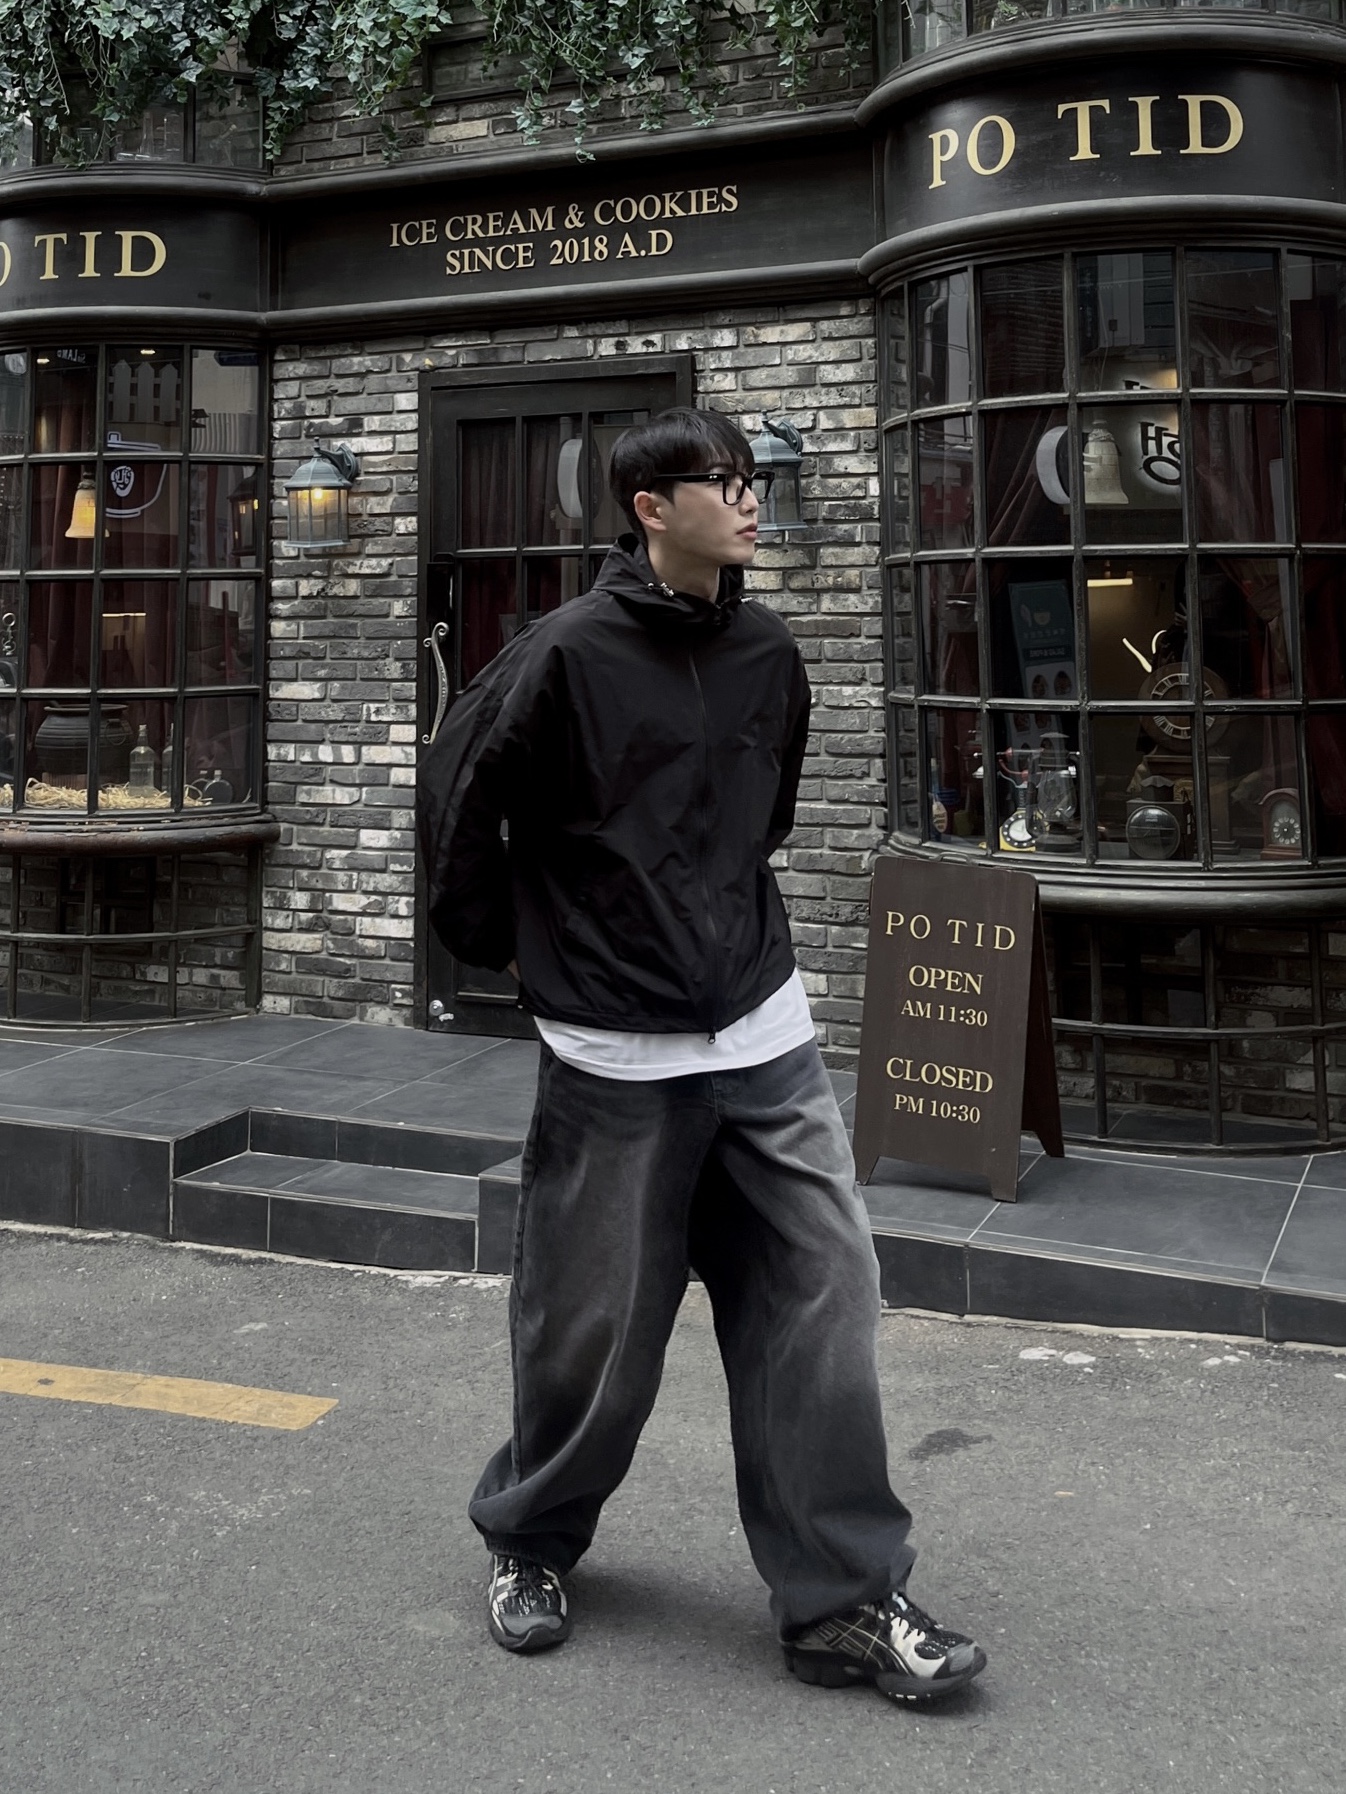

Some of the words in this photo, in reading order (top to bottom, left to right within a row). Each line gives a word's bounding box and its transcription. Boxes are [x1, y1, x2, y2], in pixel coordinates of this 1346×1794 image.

[928, 115, 1016, 189] PO
[1057, 94, 1244, 161] TID
[390, 219, 437, 247] ICE
[444, 206, 556, 241] CREAM
[563, 203, 586, 229] &
[594, 185, 739, 225] COOKIES
[34, 230, 167, 280] TID
[446, 243, 535, 275] SINCE
[549, 235, 609, 265] 2018
[615, 229, 674, 259] A.D
[885, 911, 931, 939] PO
[947, 919, 1016, 950] TID
[908, 965, 984, 995] OPEN
[901, 1000, 931, 1019] AM
[938, 1005, 988, 1027] 11:30
[886, 1057, 993, 1093] CLOSED
[894, 1094, 924, 1114] PM
[930, 1100, 981, 1124] 10:30
